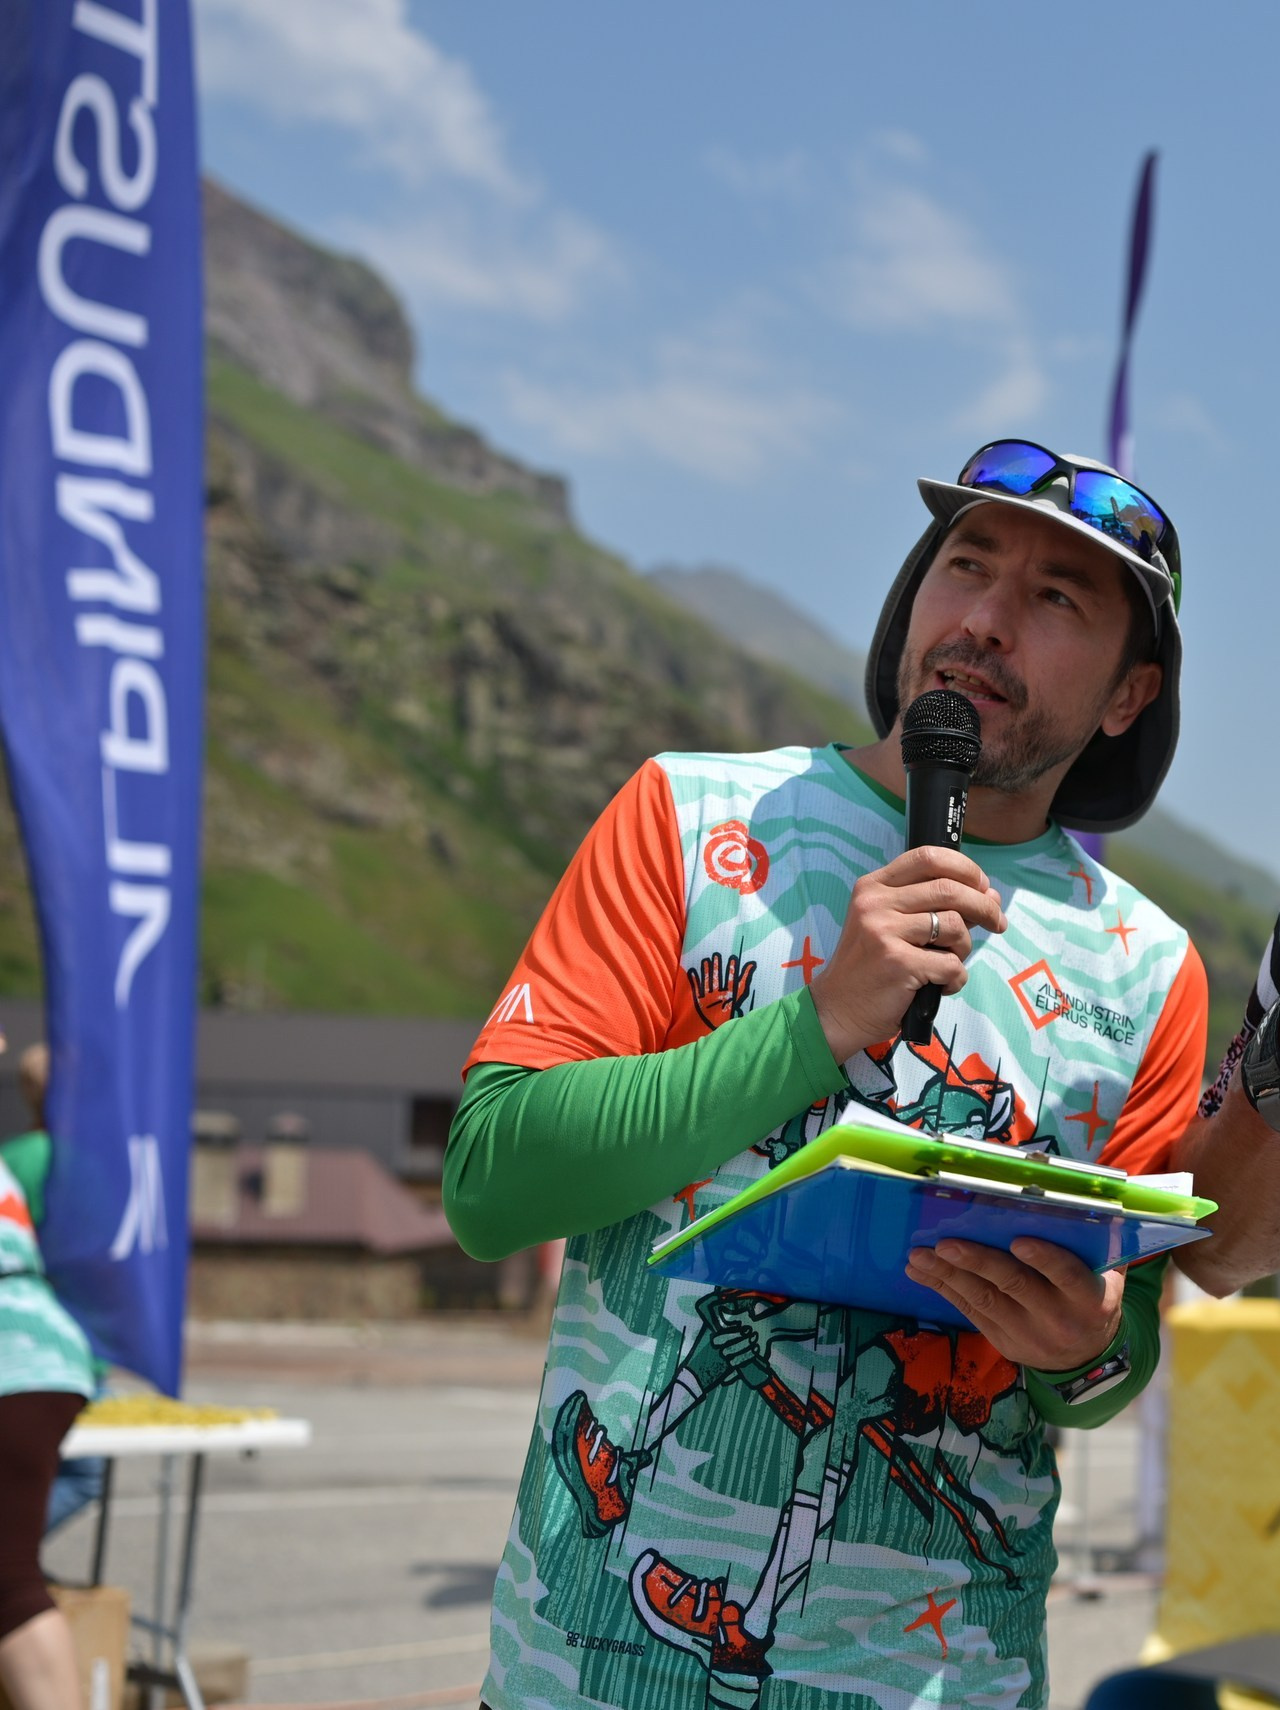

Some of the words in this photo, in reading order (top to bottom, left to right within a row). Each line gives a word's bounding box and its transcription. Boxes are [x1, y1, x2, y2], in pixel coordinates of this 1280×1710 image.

[1035, 994, 1089, 1029] ELBRUS
[1093, 1021, 1136, 1046] RACE
[1037, 983, 1136, 1031] ALPINDUSTRIA
[580, 1634, 646, 1657] LUCKYGRASS
